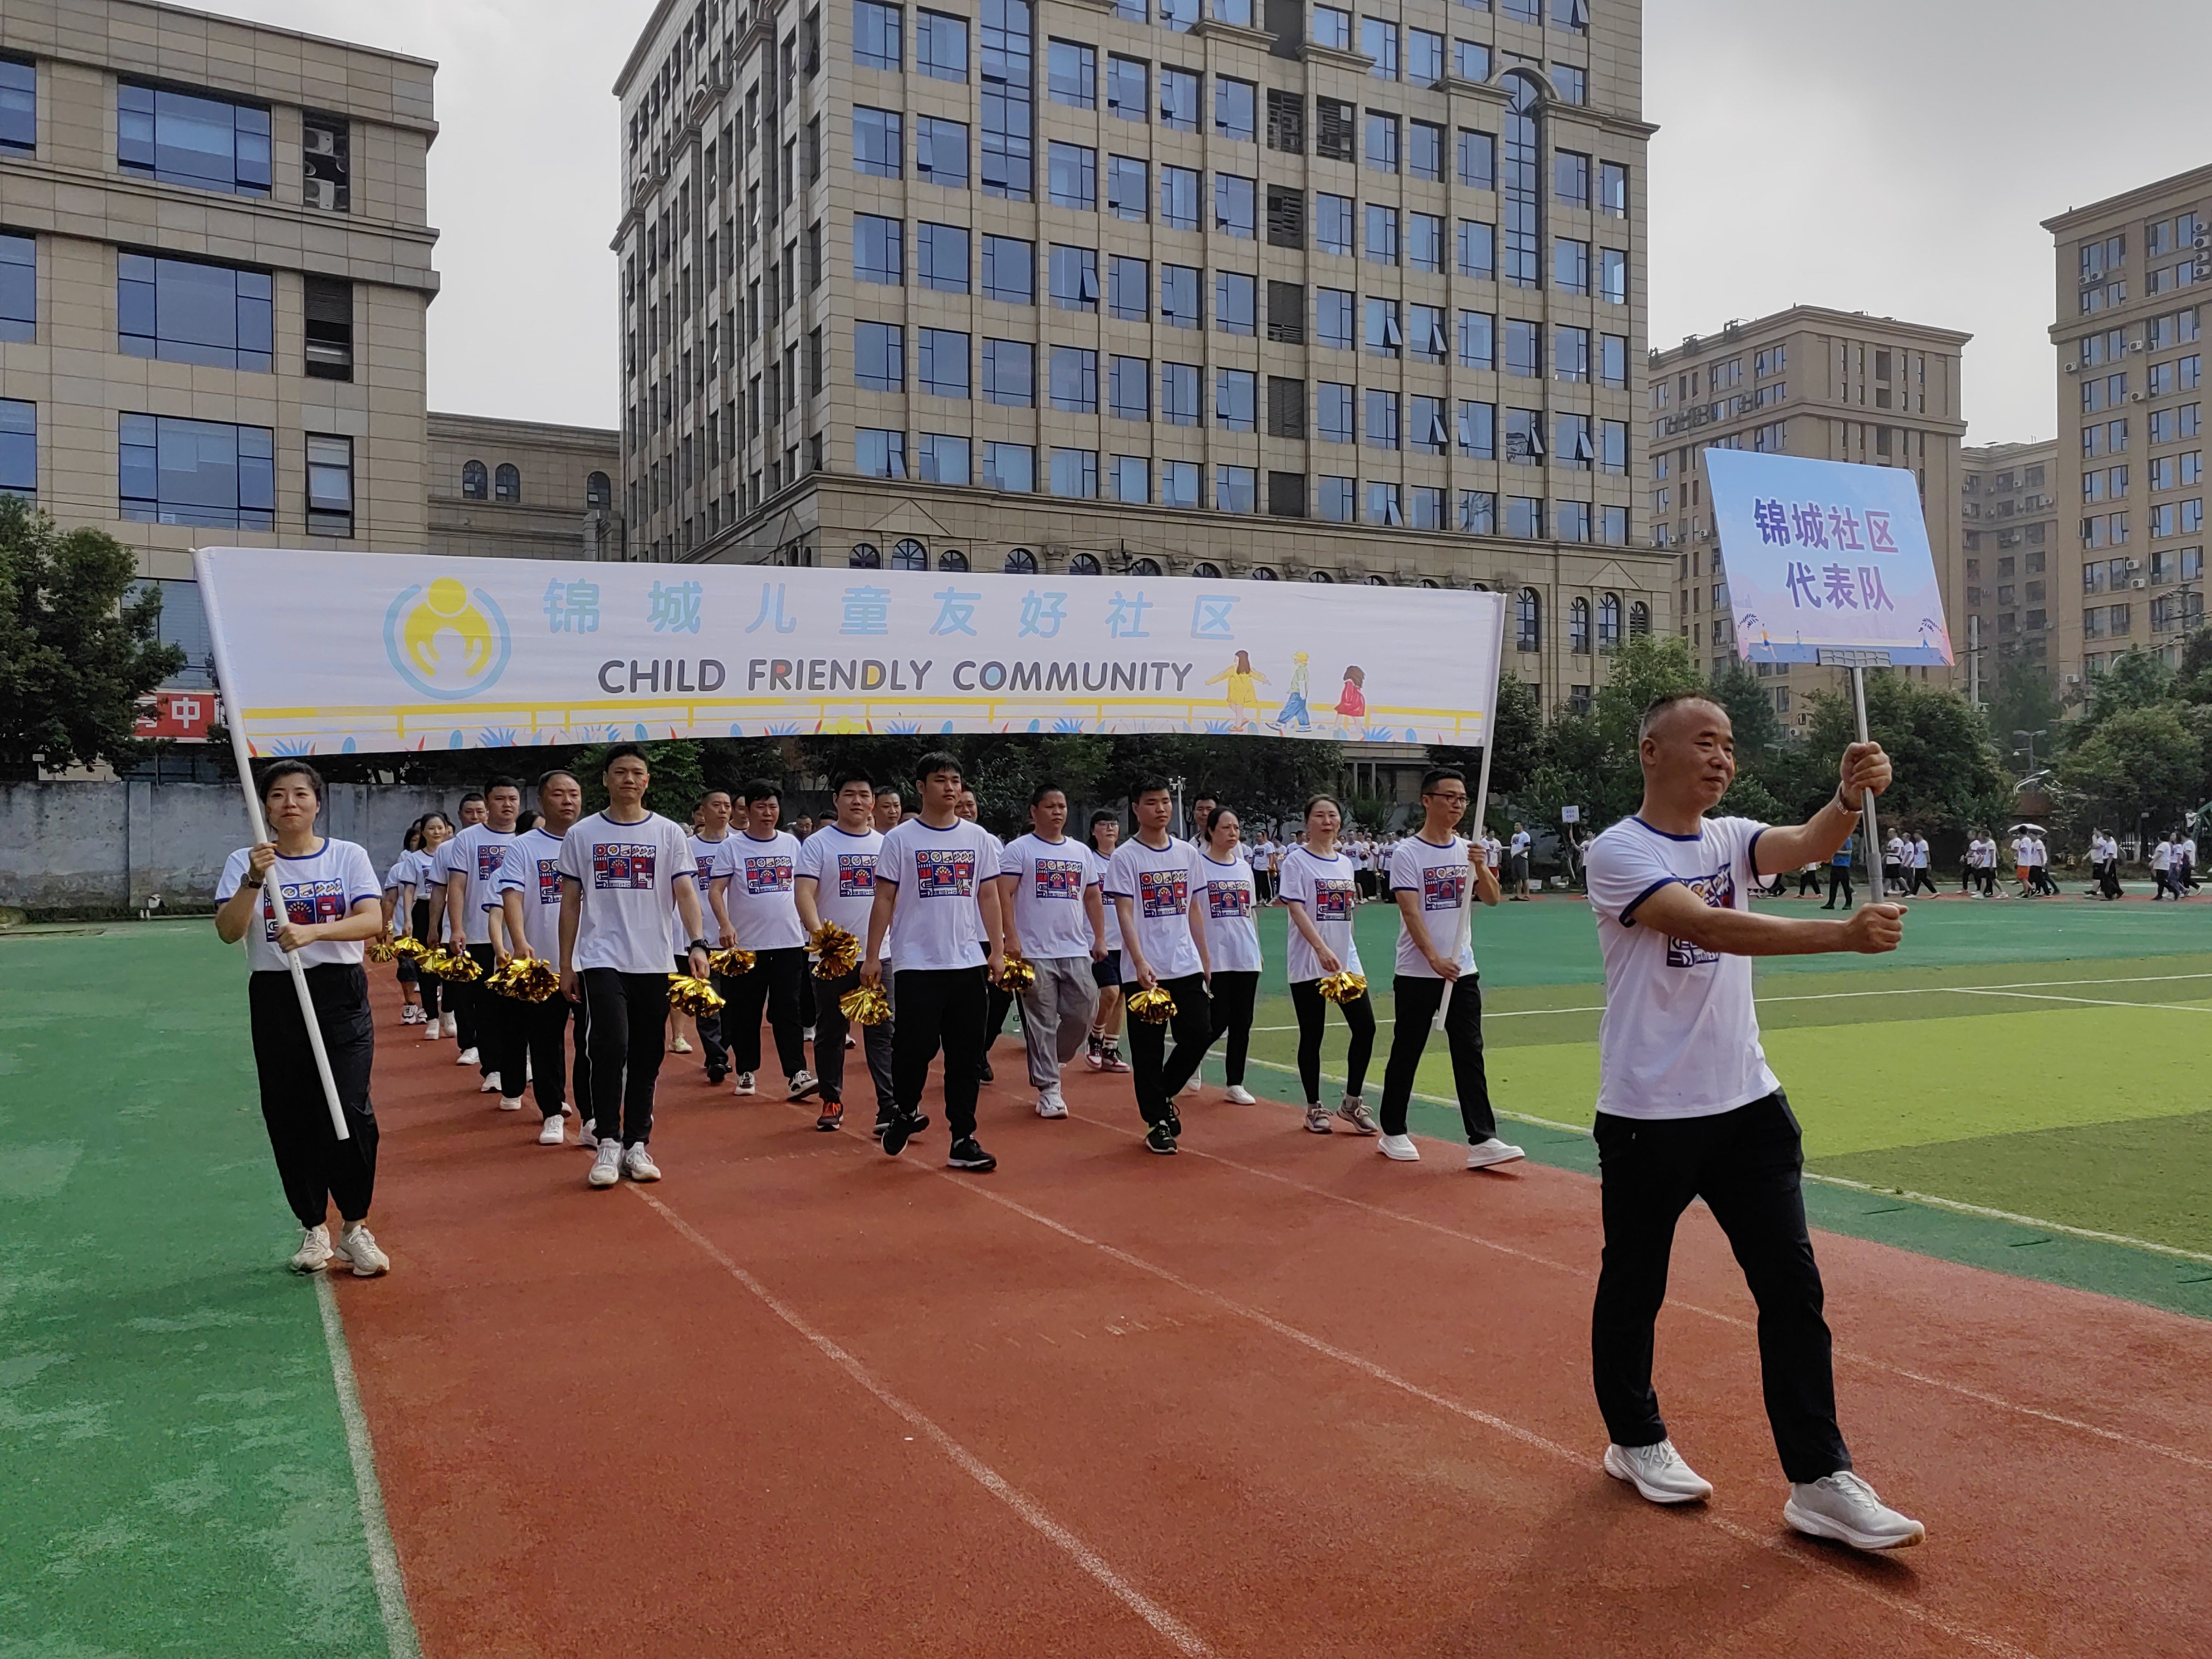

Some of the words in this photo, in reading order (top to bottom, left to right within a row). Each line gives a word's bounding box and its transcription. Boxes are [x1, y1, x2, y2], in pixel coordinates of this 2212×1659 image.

[1754, 498, 1899, 554] 锦城社区
[542, 577, 1241, 640] 锦城儿童友好社区
[1785, 561, 1895, 612] 代表队
[598, 659, 726, 694] CHILD
[748, 658, 933, 691] FRIENDLY
[953, 660, 1193, 691] COMMUNITY
